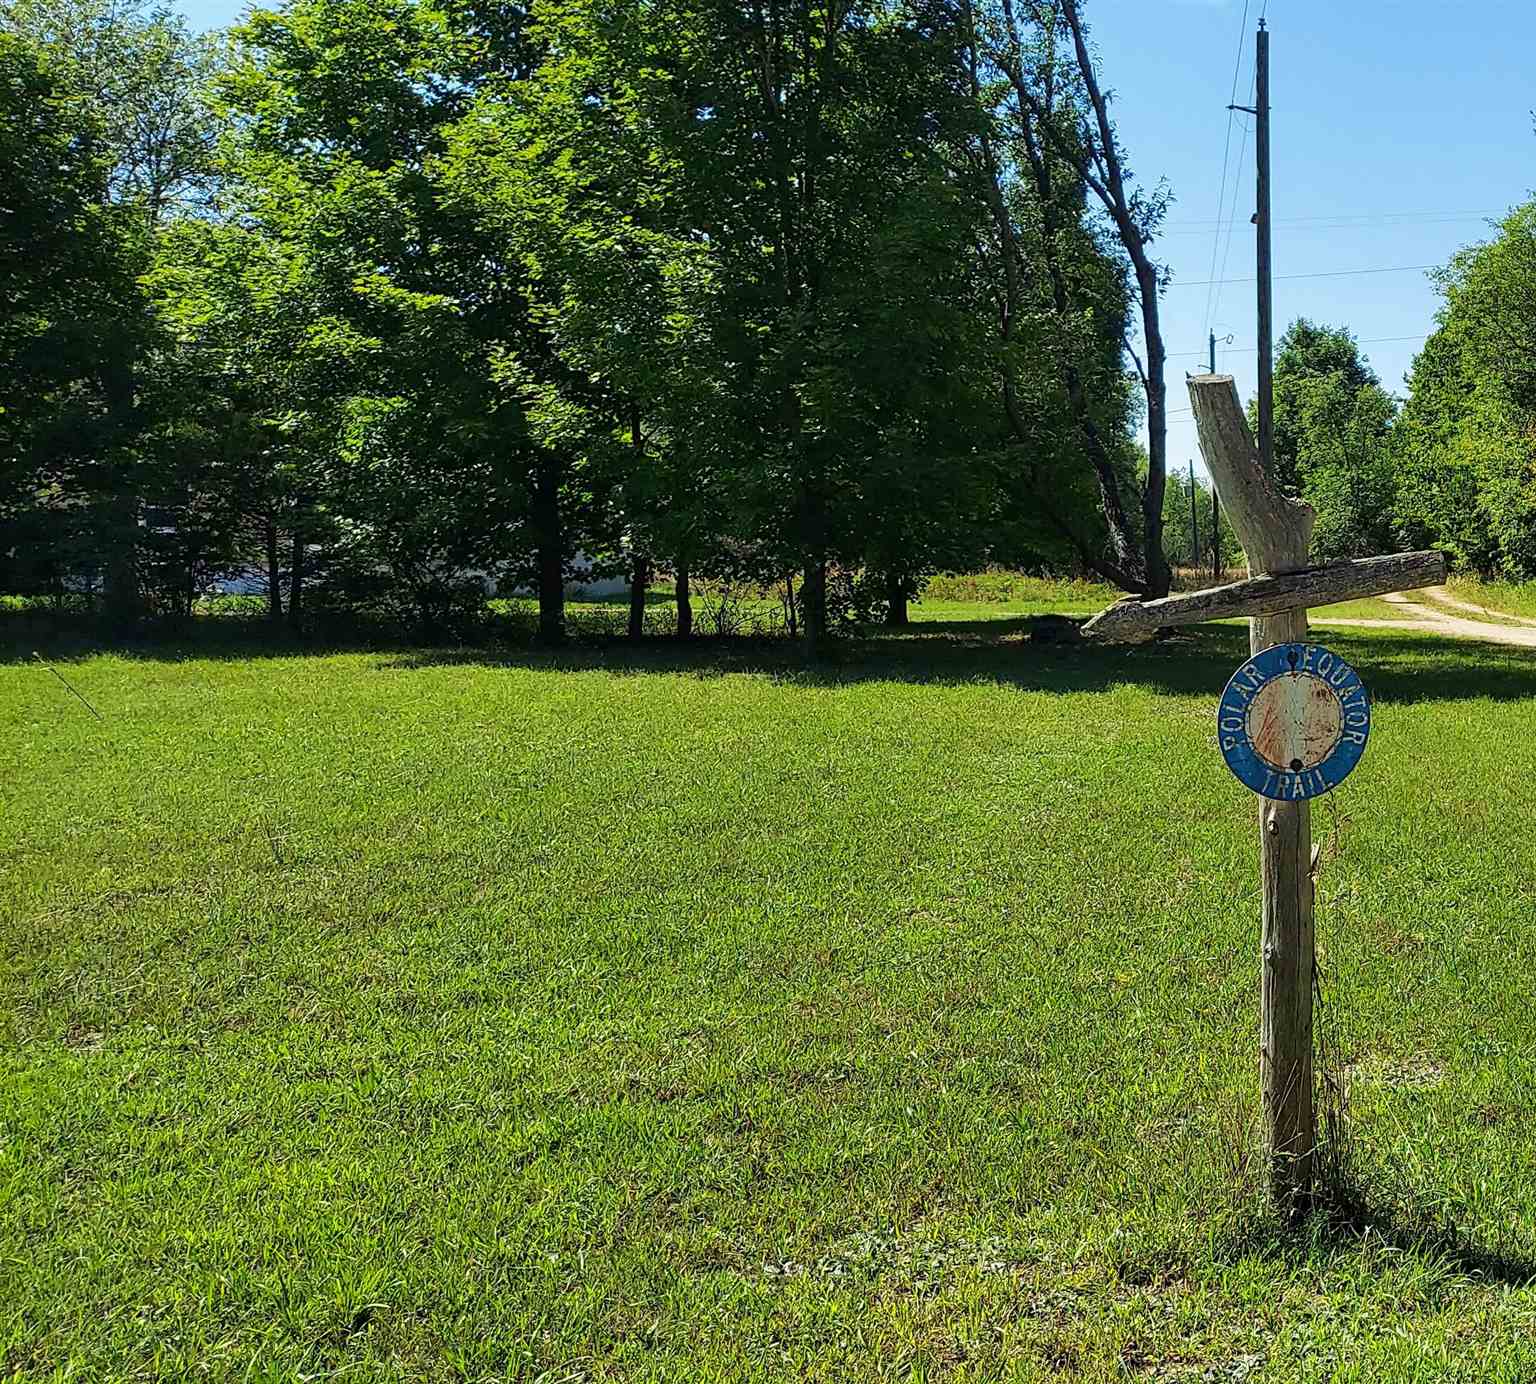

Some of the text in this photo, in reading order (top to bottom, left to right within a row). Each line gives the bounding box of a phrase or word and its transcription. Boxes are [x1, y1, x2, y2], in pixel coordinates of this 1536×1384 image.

[1221, 646, 1368, 752] POLAR EQUATOR
[1262, 768, 1334, 798] TRAIL
